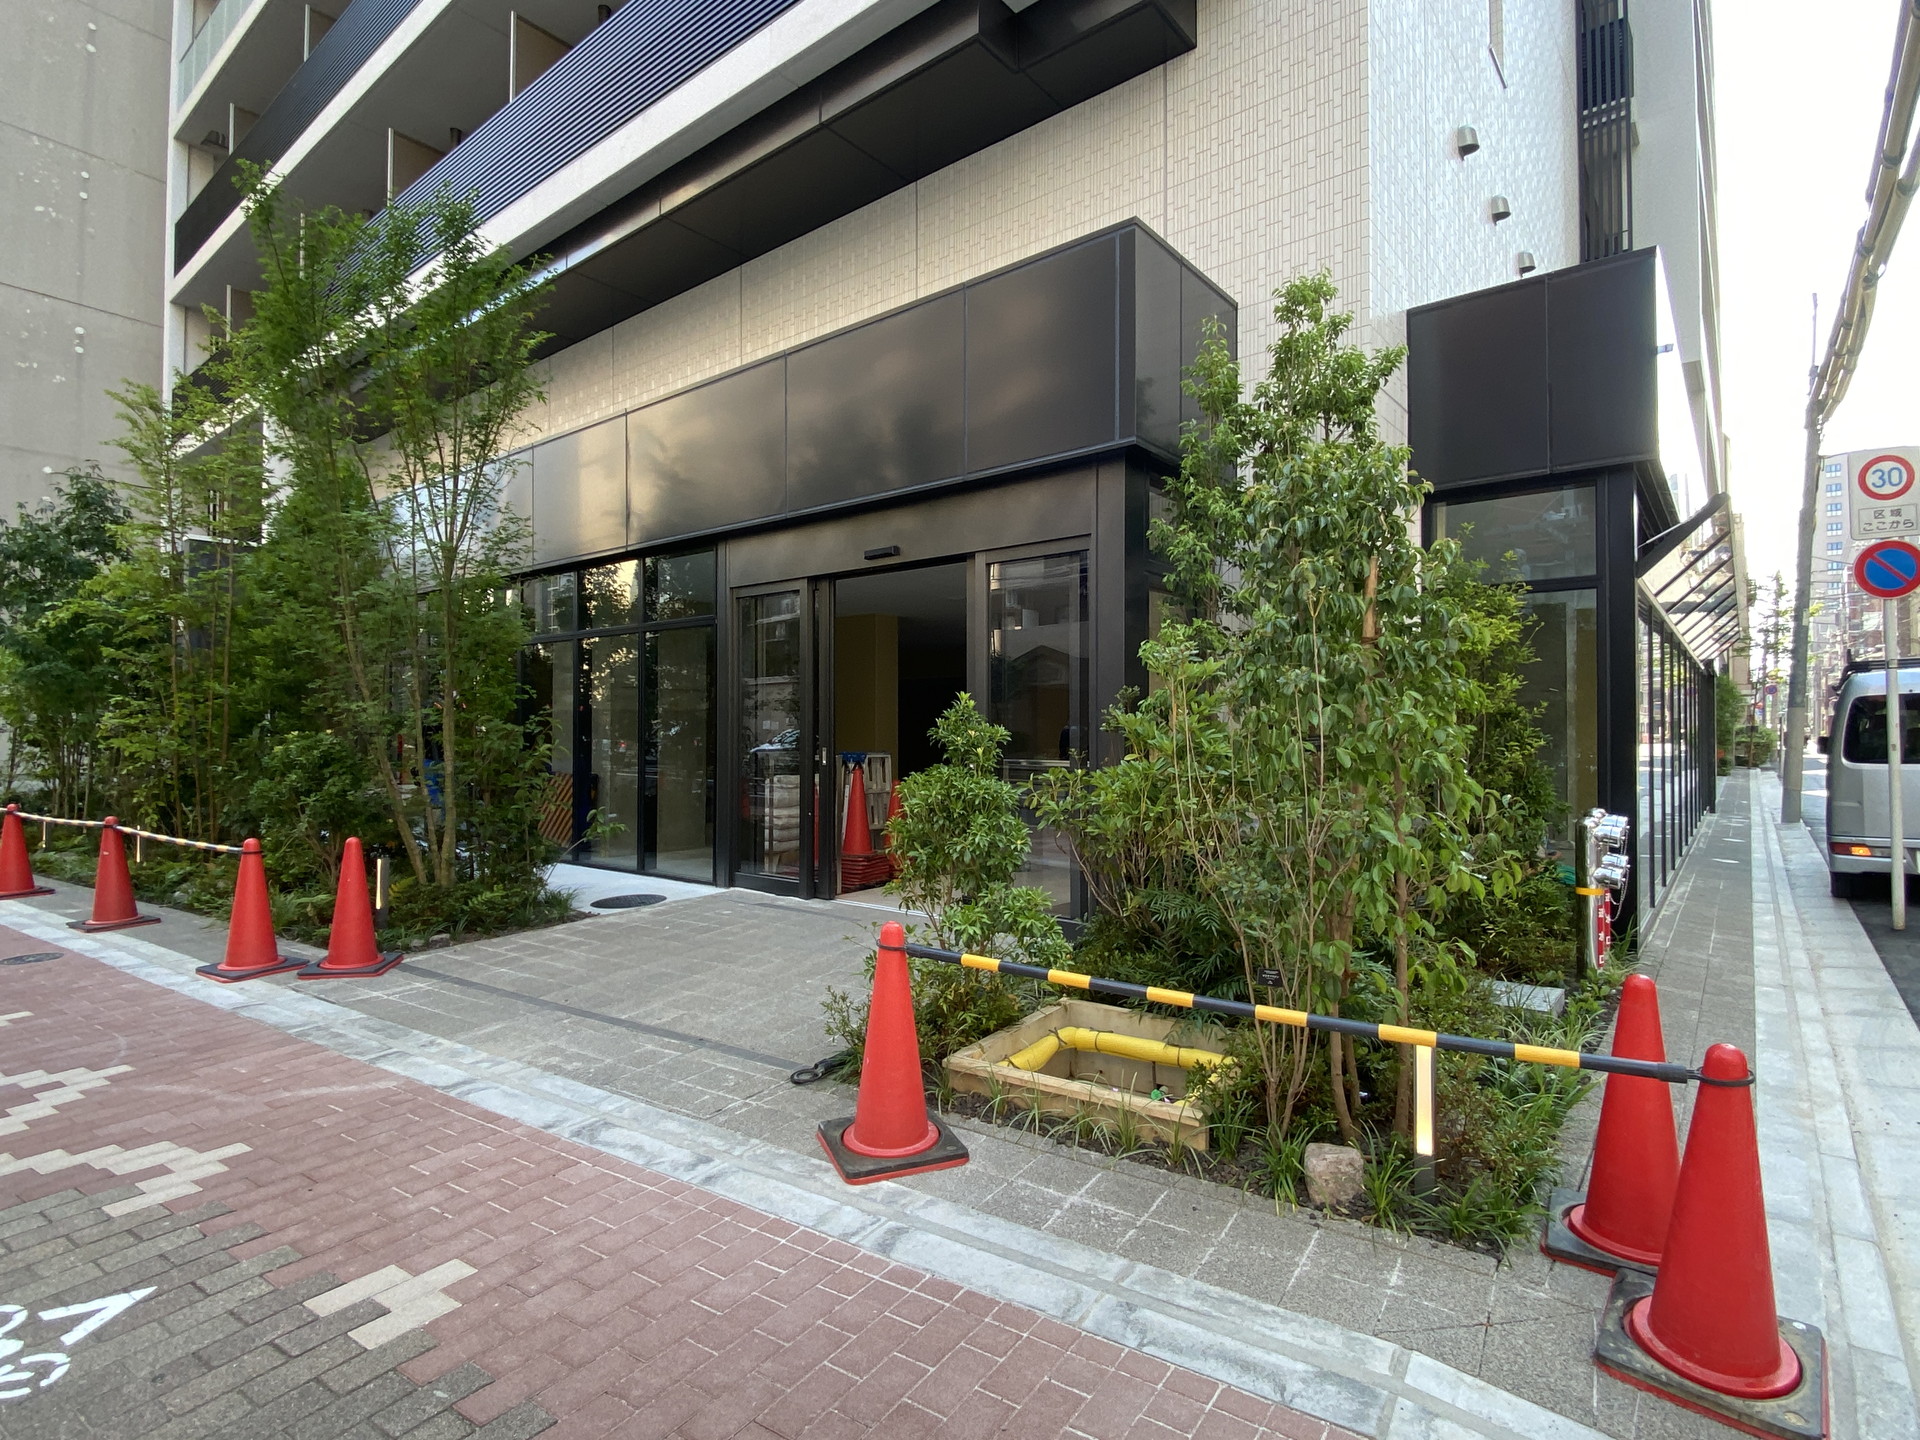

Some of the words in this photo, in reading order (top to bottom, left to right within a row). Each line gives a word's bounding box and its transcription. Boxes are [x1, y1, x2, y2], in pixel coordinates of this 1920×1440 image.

[1871, 467, 1903, 488] 30
[1873, 508, 1902, 519] 区域
[1863, 519, 1914, 532] ここから
